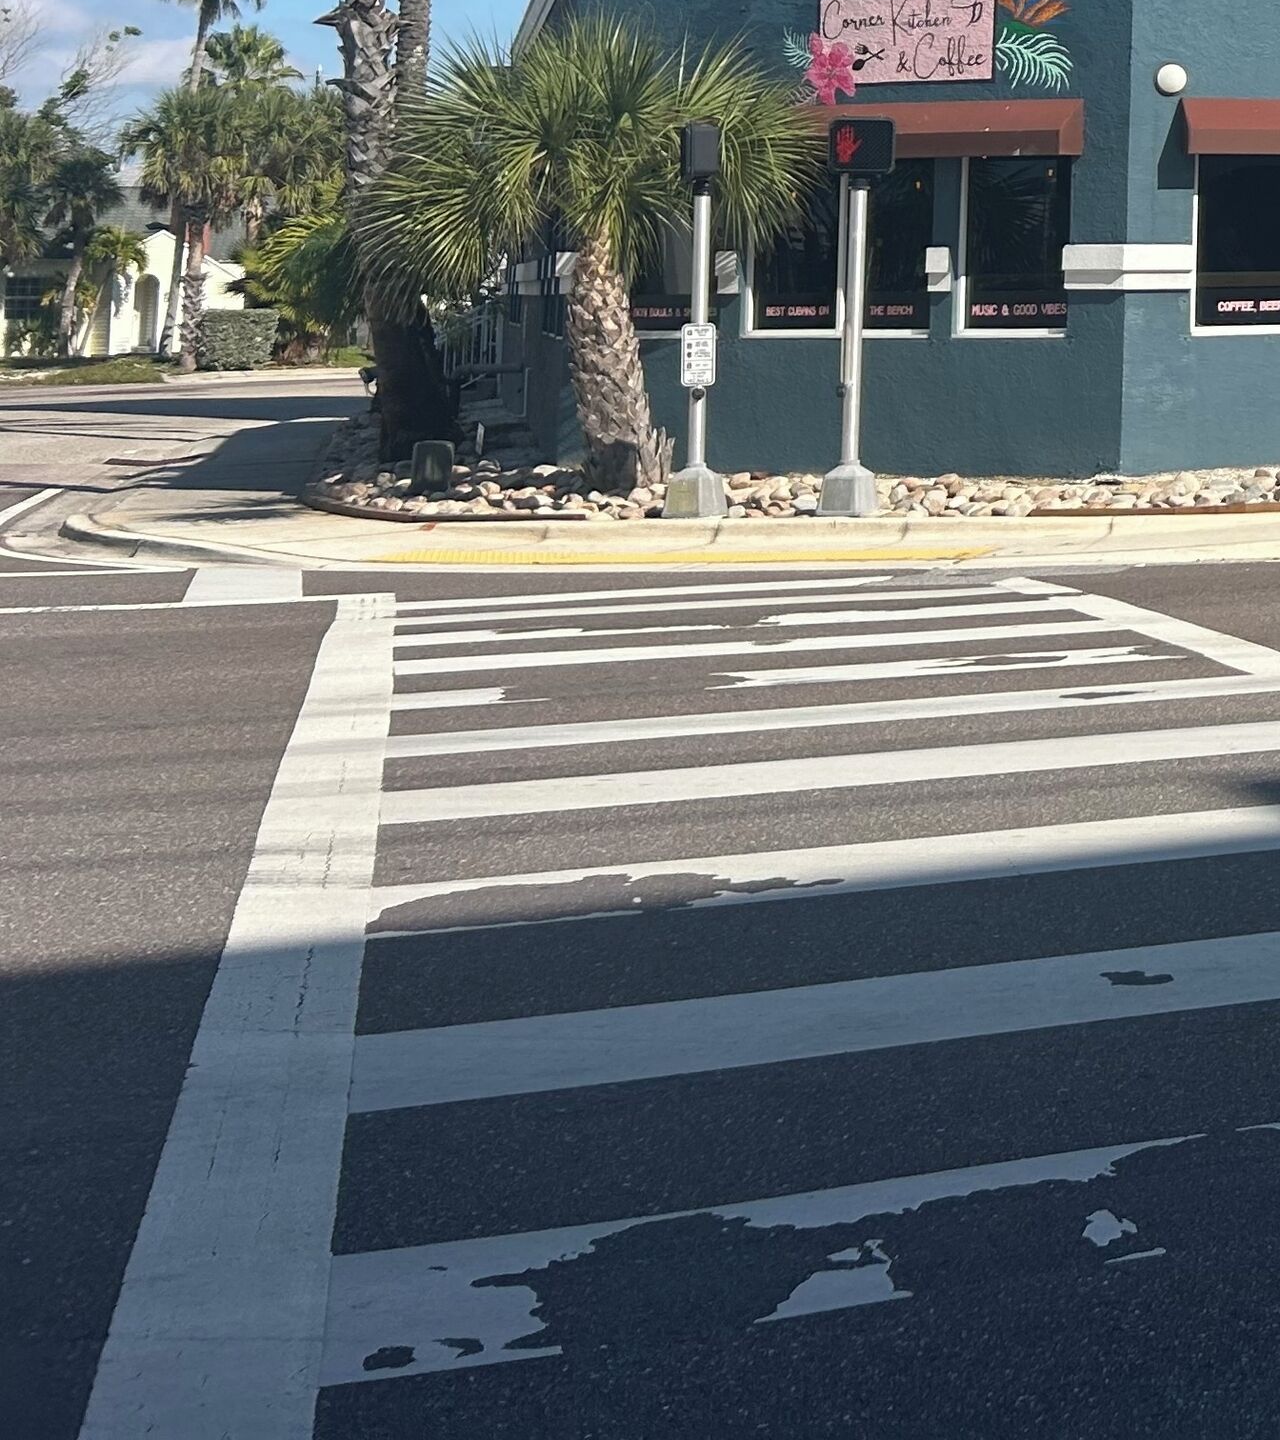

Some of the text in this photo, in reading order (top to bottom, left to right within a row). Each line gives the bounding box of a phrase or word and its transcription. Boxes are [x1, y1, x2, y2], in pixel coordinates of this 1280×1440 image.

[822, 0, 885, 40] Corner
[896, 32, 987, 79] & Coffee
[766, 306, 785, 317] BEST
[788, 305, 816, 317] CUBANS
[869, 305, 885, 316] THE
[971, 303, 1067, 316] MUSIC & GOOD VIBES
[1217, 300, 1257, 313] COFFEE,
